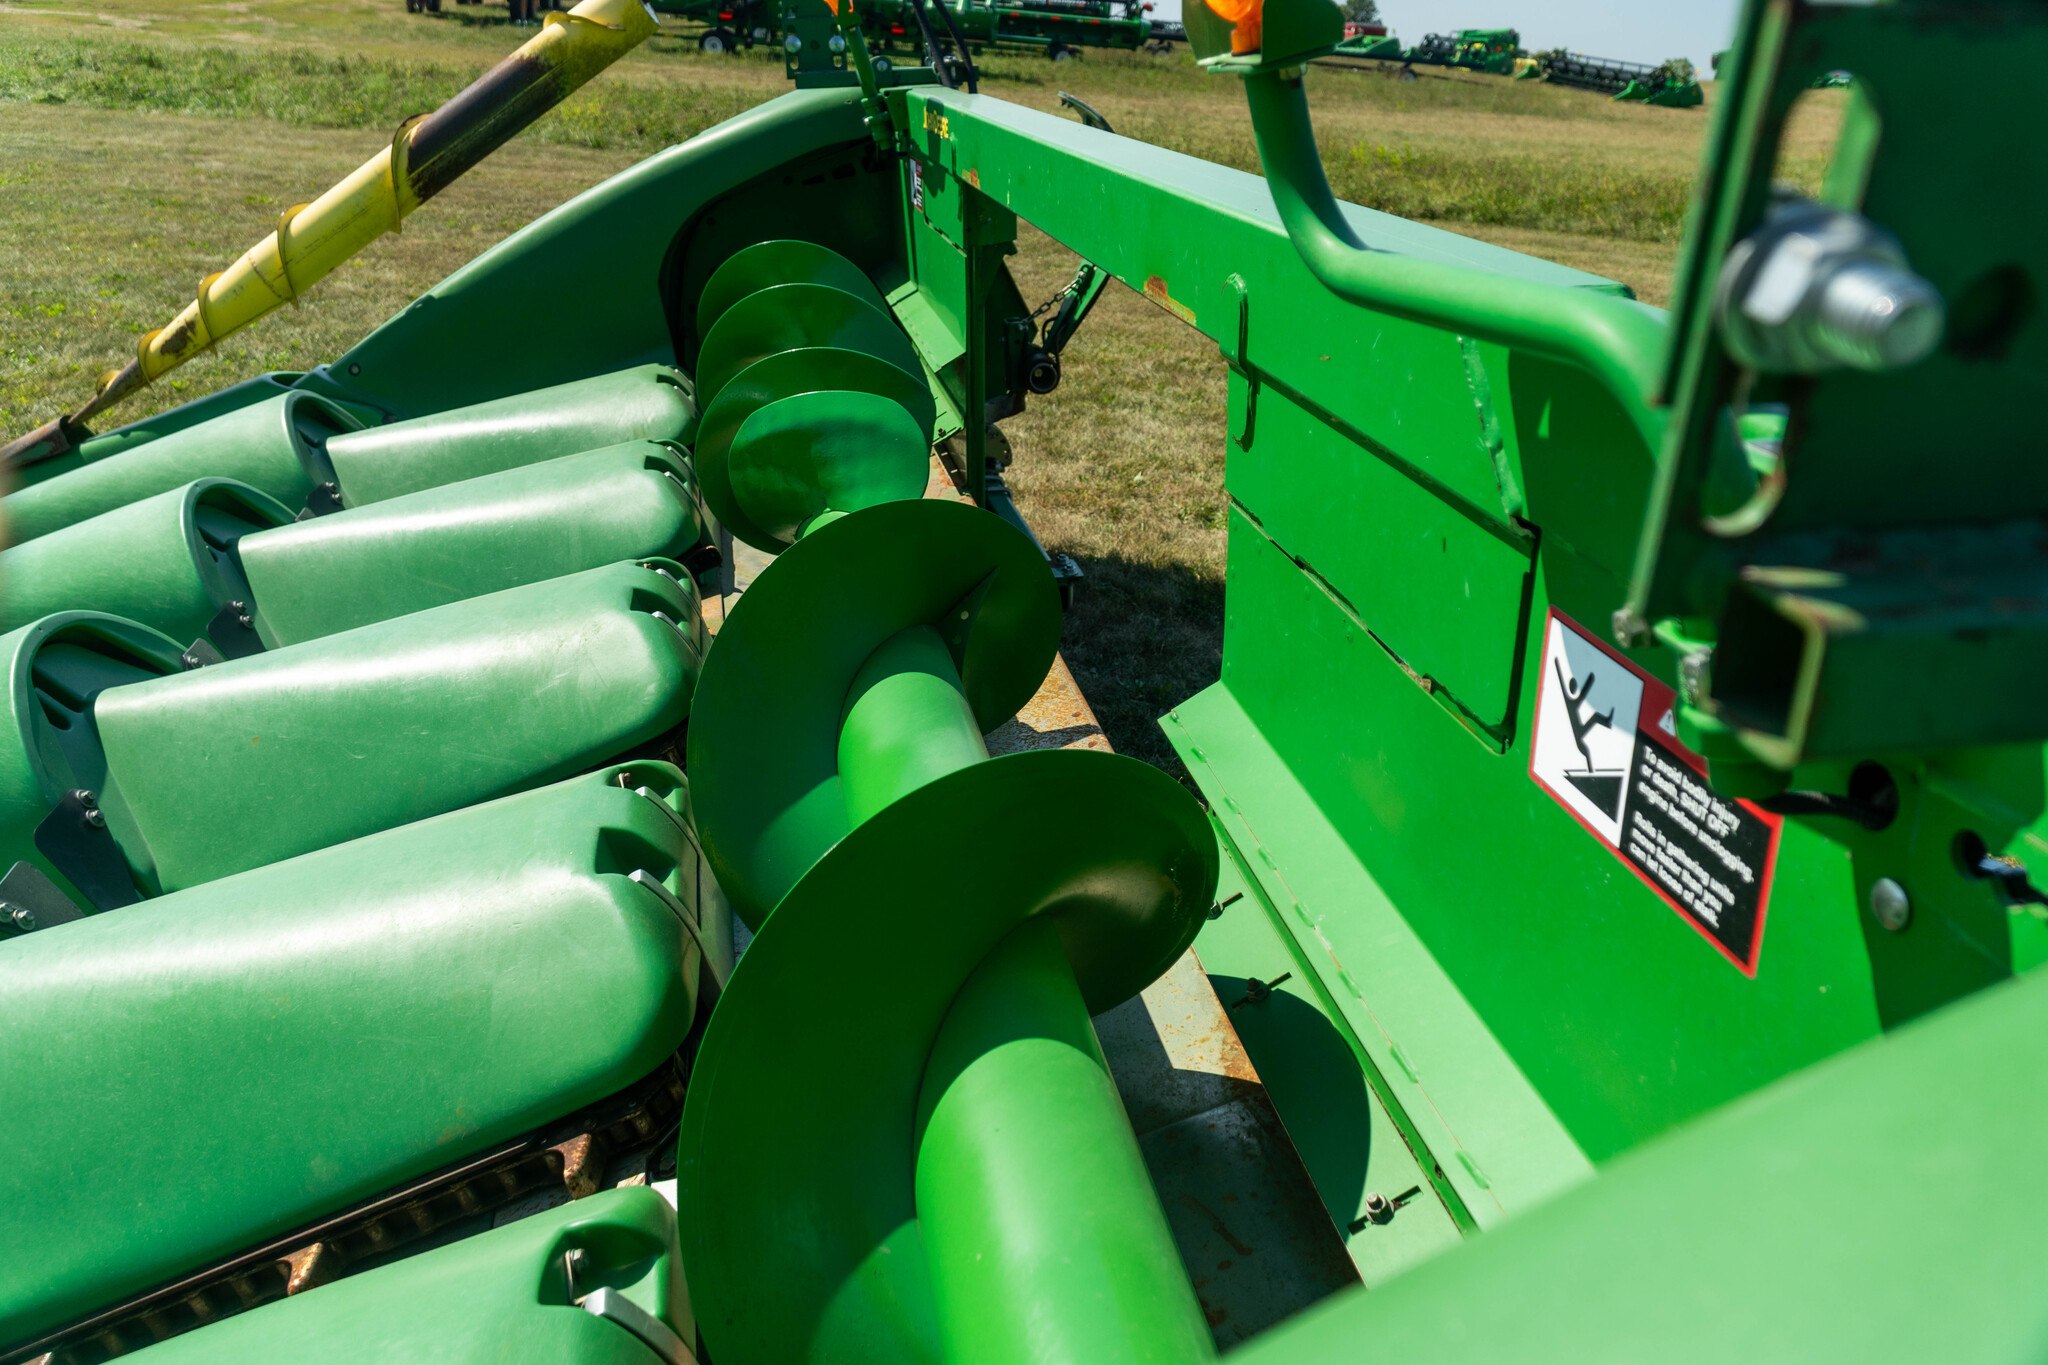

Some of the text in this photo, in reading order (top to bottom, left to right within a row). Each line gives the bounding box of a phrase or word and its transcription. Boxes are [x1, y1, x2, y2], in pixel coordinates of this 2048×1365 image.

[1637, 781, 1668, 812] engine
[1668, 802, 1698, 836] before
[1640, 764, 1653, 778] or
[1679, 792, 1708, 822] SHUT
[1705, 813, 1730, 838] OFF
[1644, 745, 1740, 831] To avoid bodily injury
[1629, 842, 1646, 862] can
[1646, 854, 1659, 873] let
[1657, 865, 1683, 895] loose
[1682, 889, 1695, 904] of
[1631, 828, 1722, 913] move faster than you
[1633, 811, 1735, 906] Rolls in gathering units
